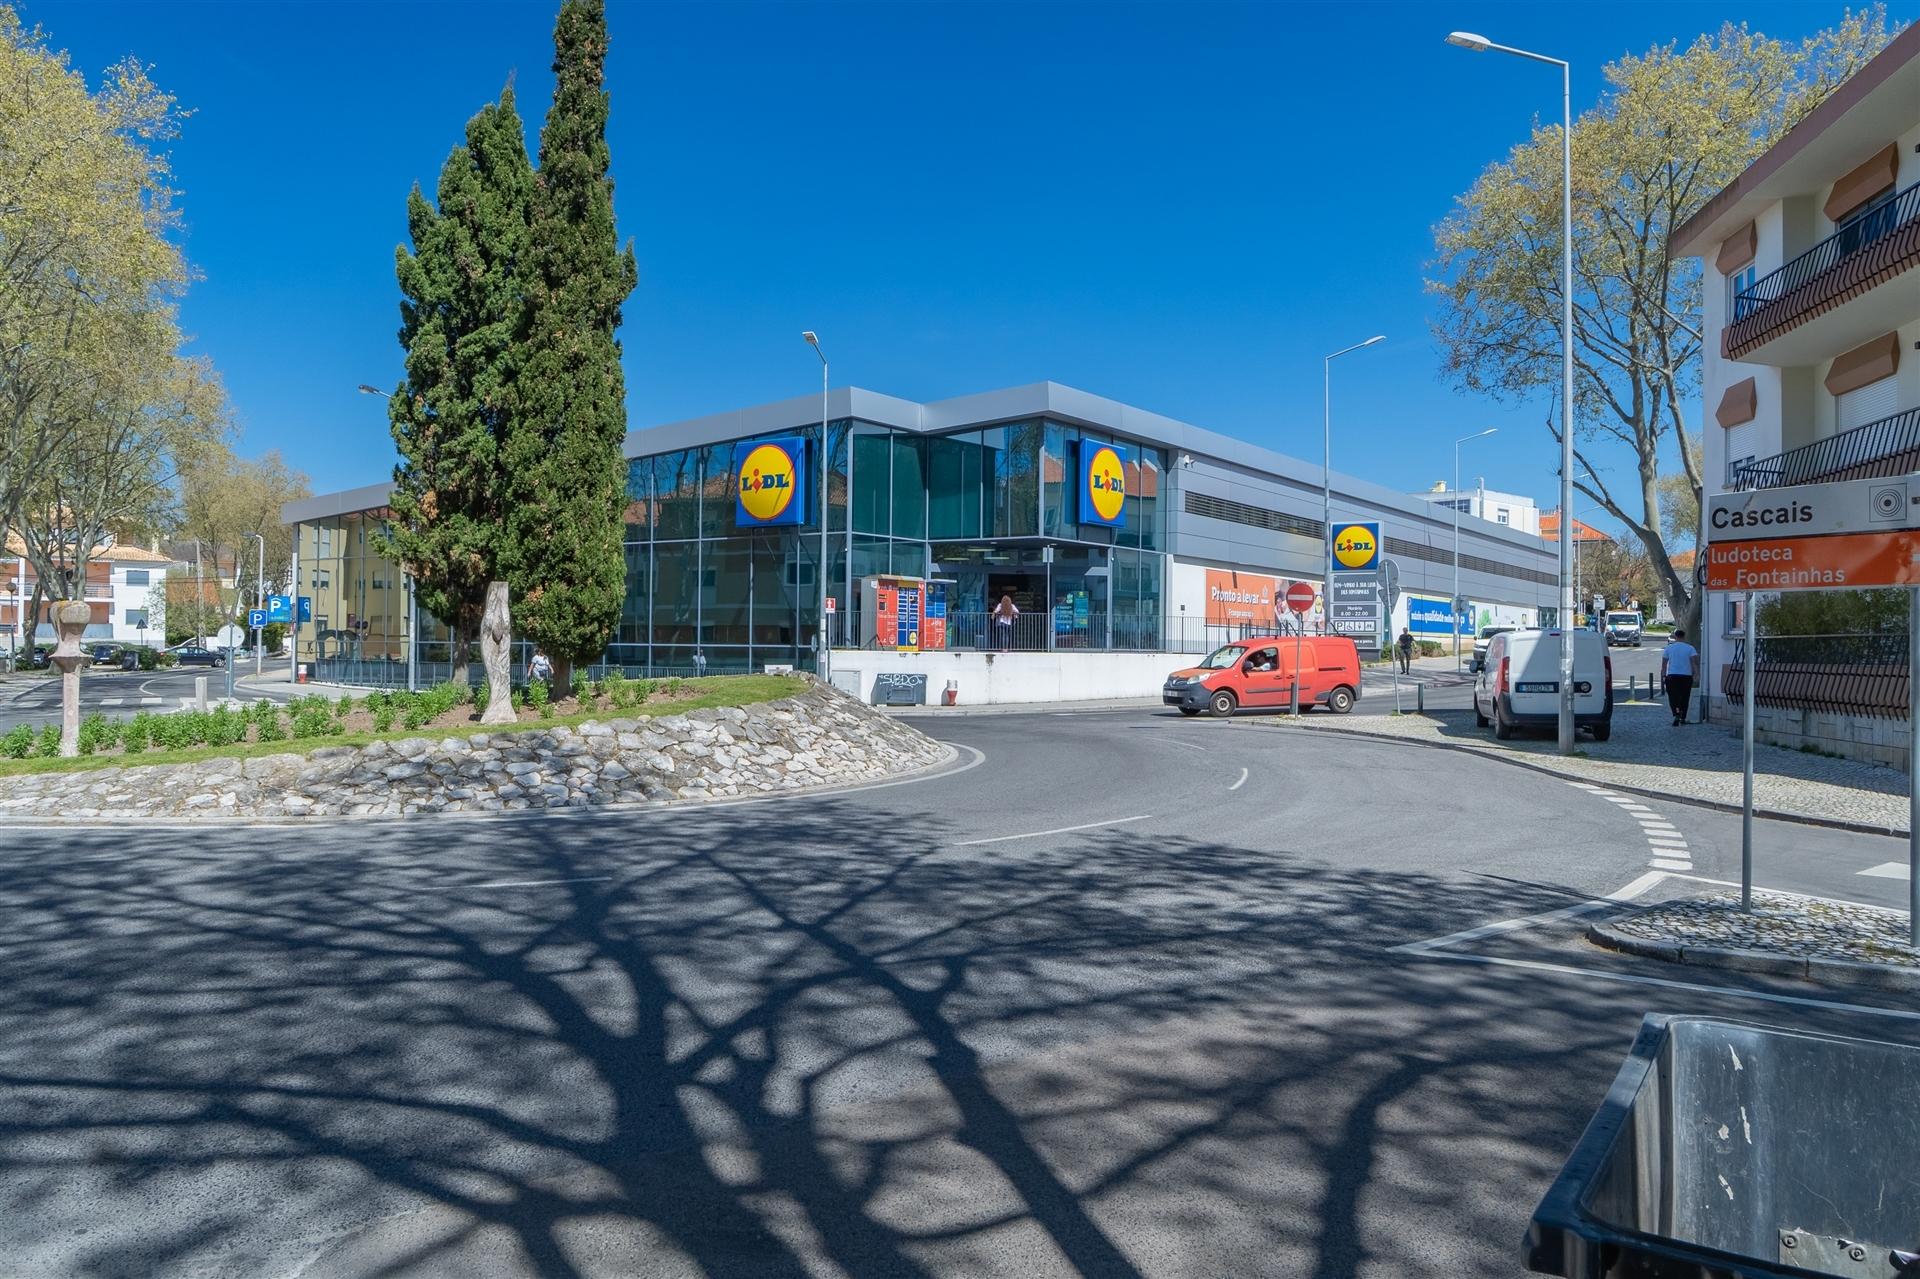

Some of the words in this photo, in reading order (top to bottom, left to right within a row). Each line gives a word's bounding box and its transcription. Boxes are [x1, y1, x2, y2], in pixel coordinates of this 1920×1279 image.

[1711, 501, 1813, 529] Cascais
[1711, 547, 1793, 564] ludoteca
[1711, 577, 1728, 586] das
[1736, 567, 1846, 585] Fontainhas
[1211, 586, 1236, 604] Pronto
[1237, 593, 1243, 603] a
[1243, 588, 1260, 604] levar
[270, 600, 282, 612] P
[253, 613, 263, 625] P
